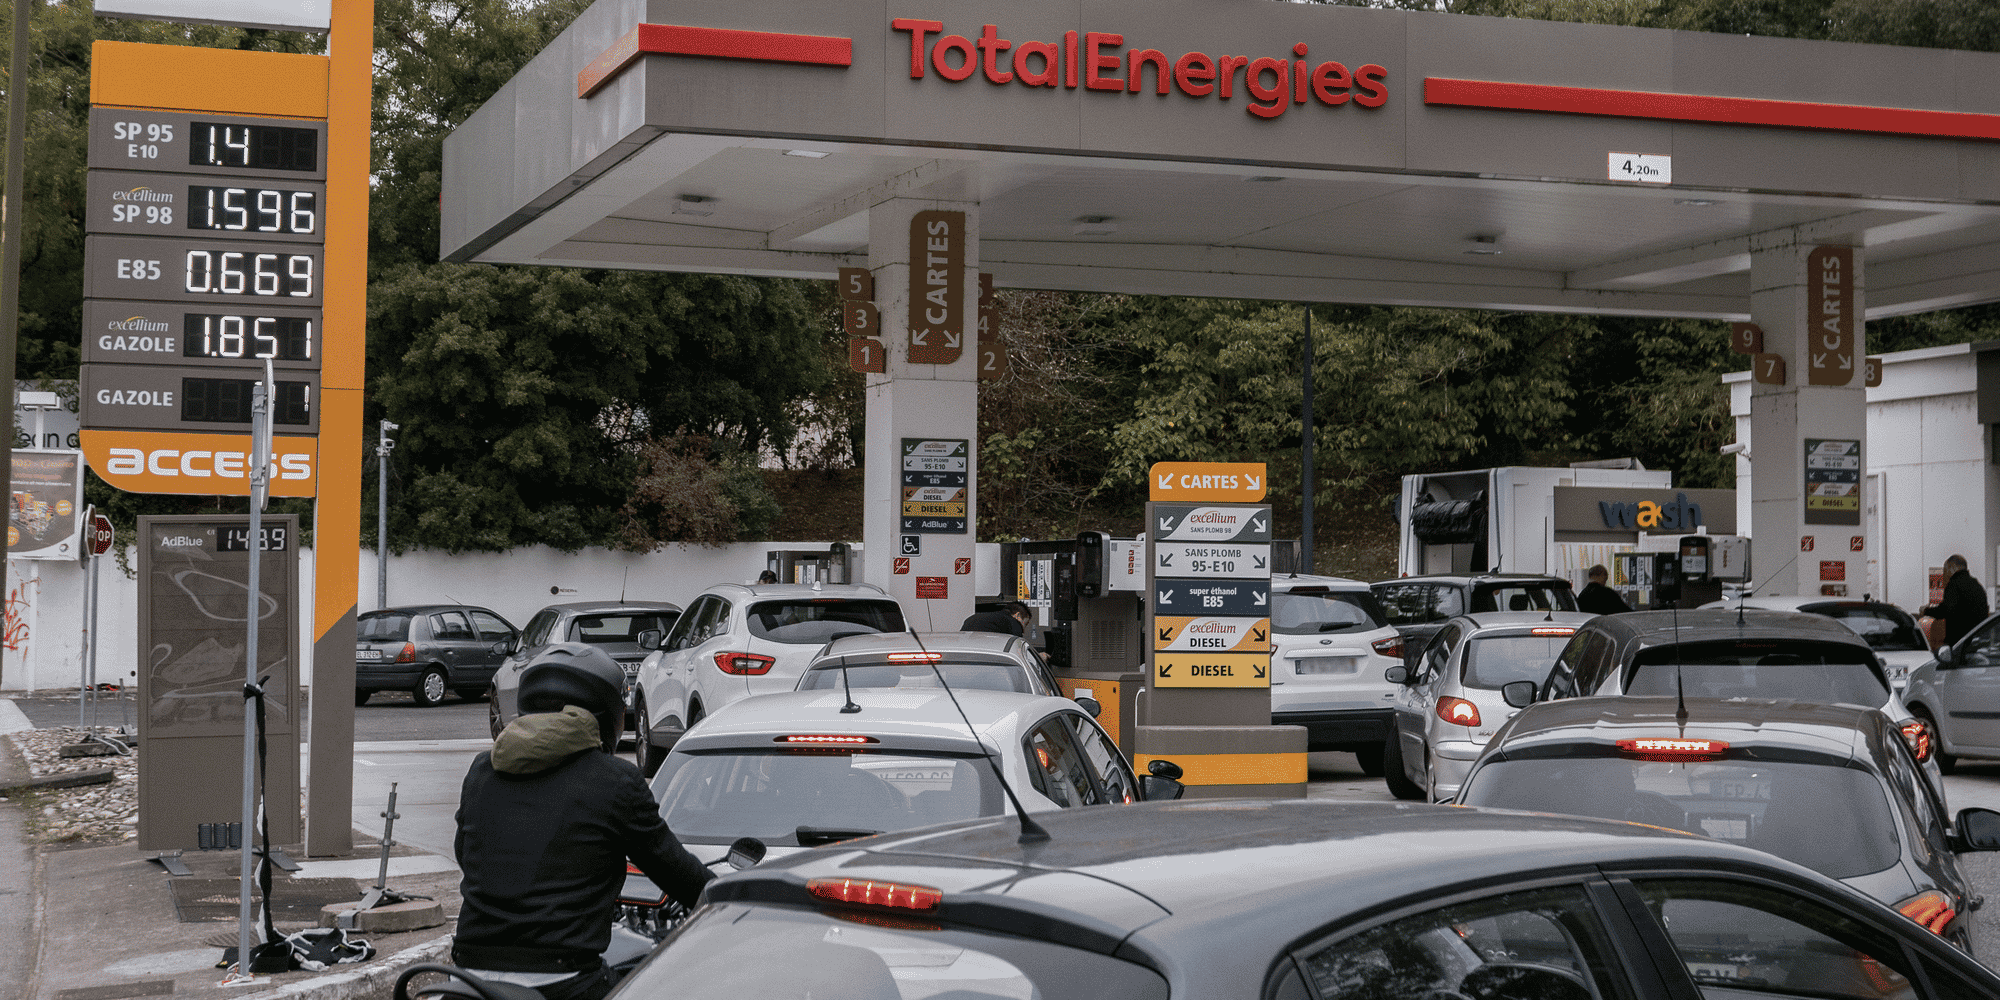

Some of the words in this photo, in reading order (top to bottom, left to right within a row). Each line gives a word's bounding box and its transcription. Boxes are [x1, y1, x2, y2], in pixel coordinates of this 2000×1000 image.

[891, 17, 1389, 118] TotalEnergies
[114, 122, 142, 140] SP
[147, 124, 174, 143] 95
[209, 126, 249, 165] 1.4
[112, 188, 173, 202] excellium
[113, 204, 141, 222] SP
[146, 206, 173, 224] 98
[207, 188, 315, 233] 1.596
[117, 259, 161, 280] E85
[186, 250, 313, 296] 0.669
[926, 220, 949, 325] CARTES
[850, 274, 862, 294] 5
[1823, 256, 1840, 350] CARTES
[108, 318, 169, 332] excellium
[855, 309, 867, 329] 3
[978, 315, 990, 335] 4
[98, 335, 175, 352] GAZOLE
[204, 316, 311, 359] 1.851
[1742, 329, 1753, 347] 9
[861, 345, 870, 365] 1
[983, 351, 996, 371] 2
[1765, 359, 1775, 378] 7
[1865, 363, 1875, 381] 8
[97, 389, 173, 406] GAZOLE
[1181, 474, 1239, 490] CARTES
[1190, 512, 1236, 523] excellium
[1599, 492, 1702, 530] wash
[161, 536, 203, 547] AdBlue
[1185, 548, 1208, 557] SANS
[1211, 549, 1242, 557] PLOMB
[1192, 560, 1235, 573] 95-E10
[1189, 588, 1210, 597] super
[1210, 586, 1237, 595] éthanol
[1203, 595, 1224, 607] E85
[1190, 622, 1236, 634] excellium
[1190, 638, 1227, 648] DIESEL
[1191, 665, 1234, 677] DIESEL
